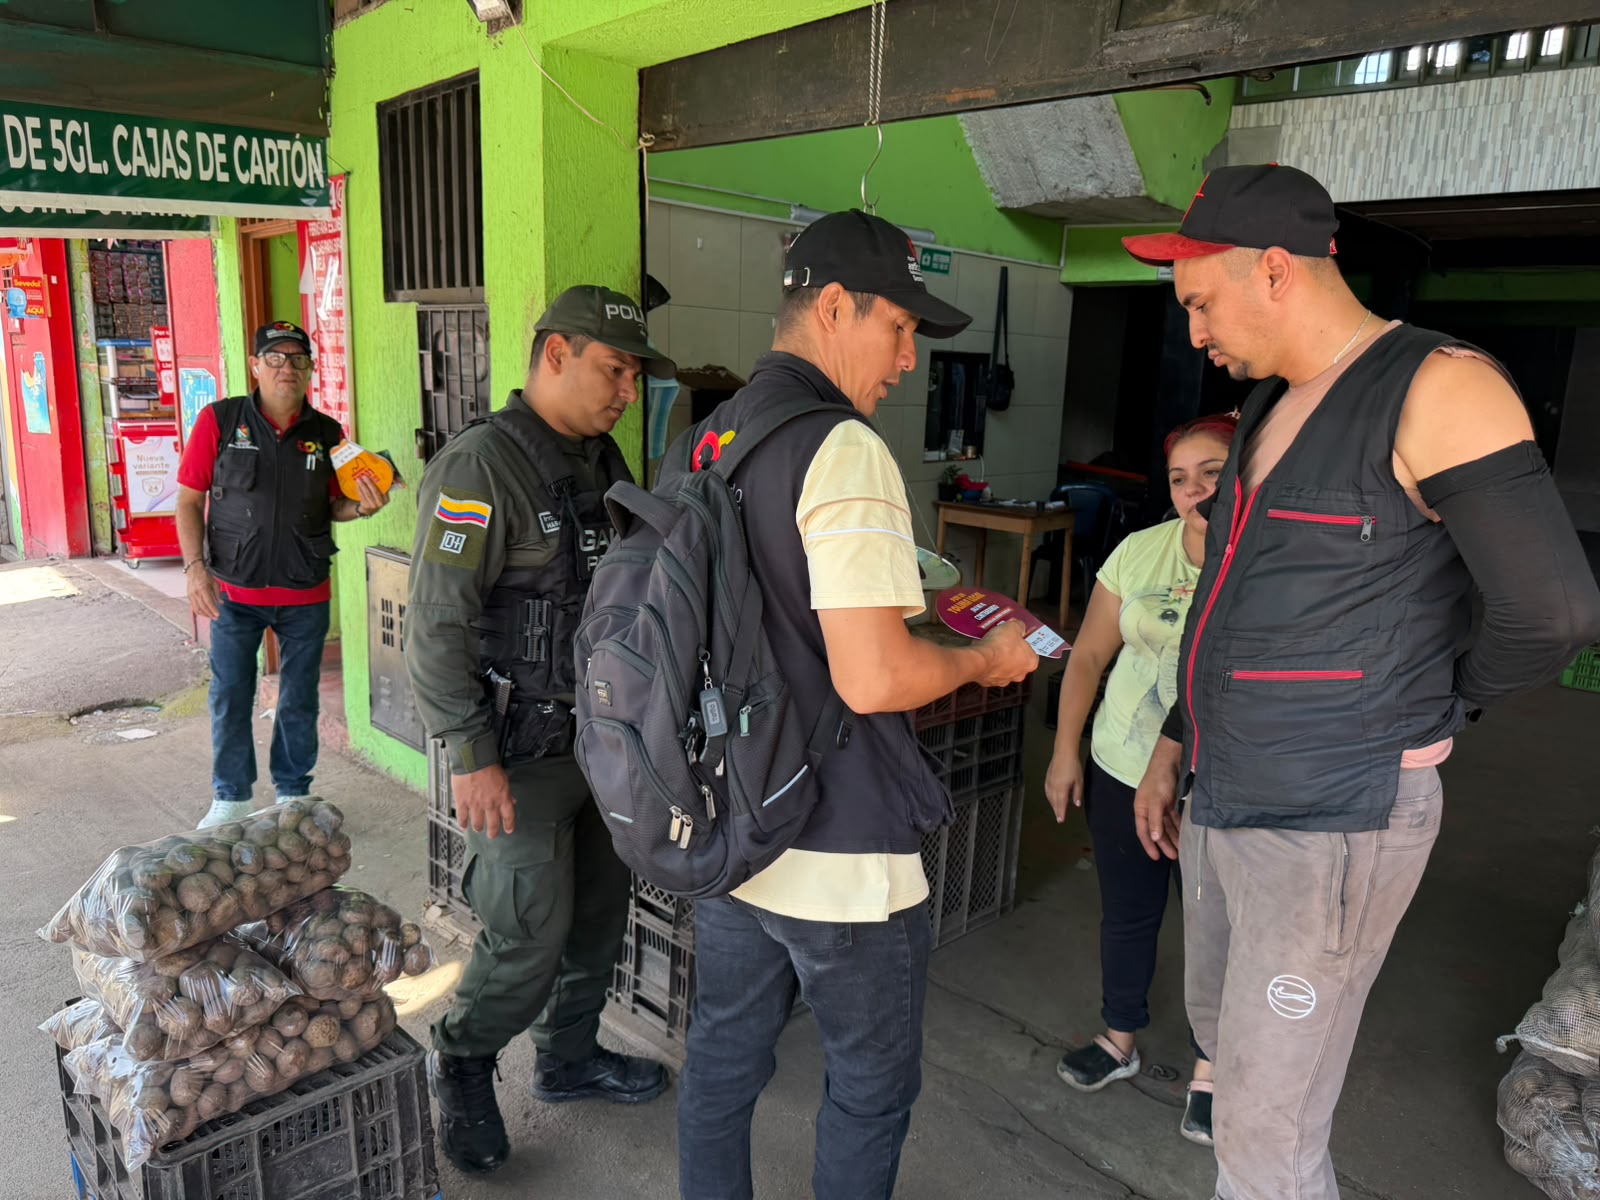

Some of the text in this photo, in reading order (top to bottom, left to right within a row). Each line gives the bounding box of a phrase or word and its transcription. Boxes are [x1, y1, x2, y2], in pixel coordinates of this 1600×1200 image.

[3, 114, 326, 188] DE 5GL. CAJAS DE CARTÓN
